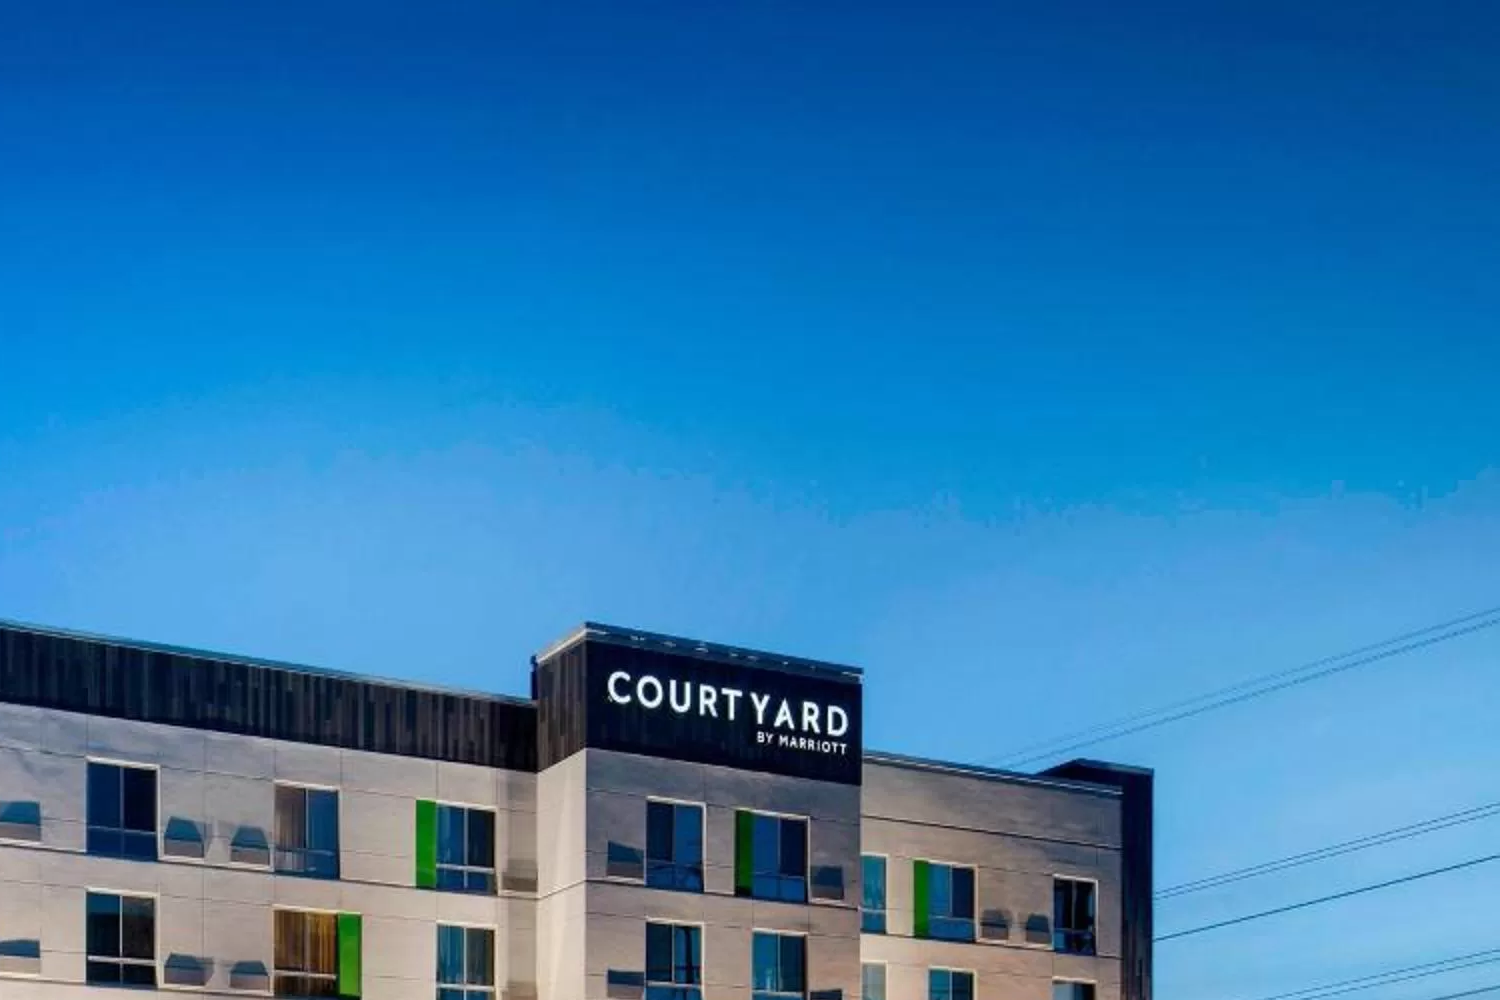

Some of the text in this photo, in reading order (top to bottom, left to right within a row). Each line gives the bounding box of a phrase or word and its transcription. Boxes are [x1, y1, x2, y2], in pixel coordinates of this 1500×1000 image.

[607, 671, 849, 737] COURTYARD
[756, 731, 847, 756] BY MARRIOTT
